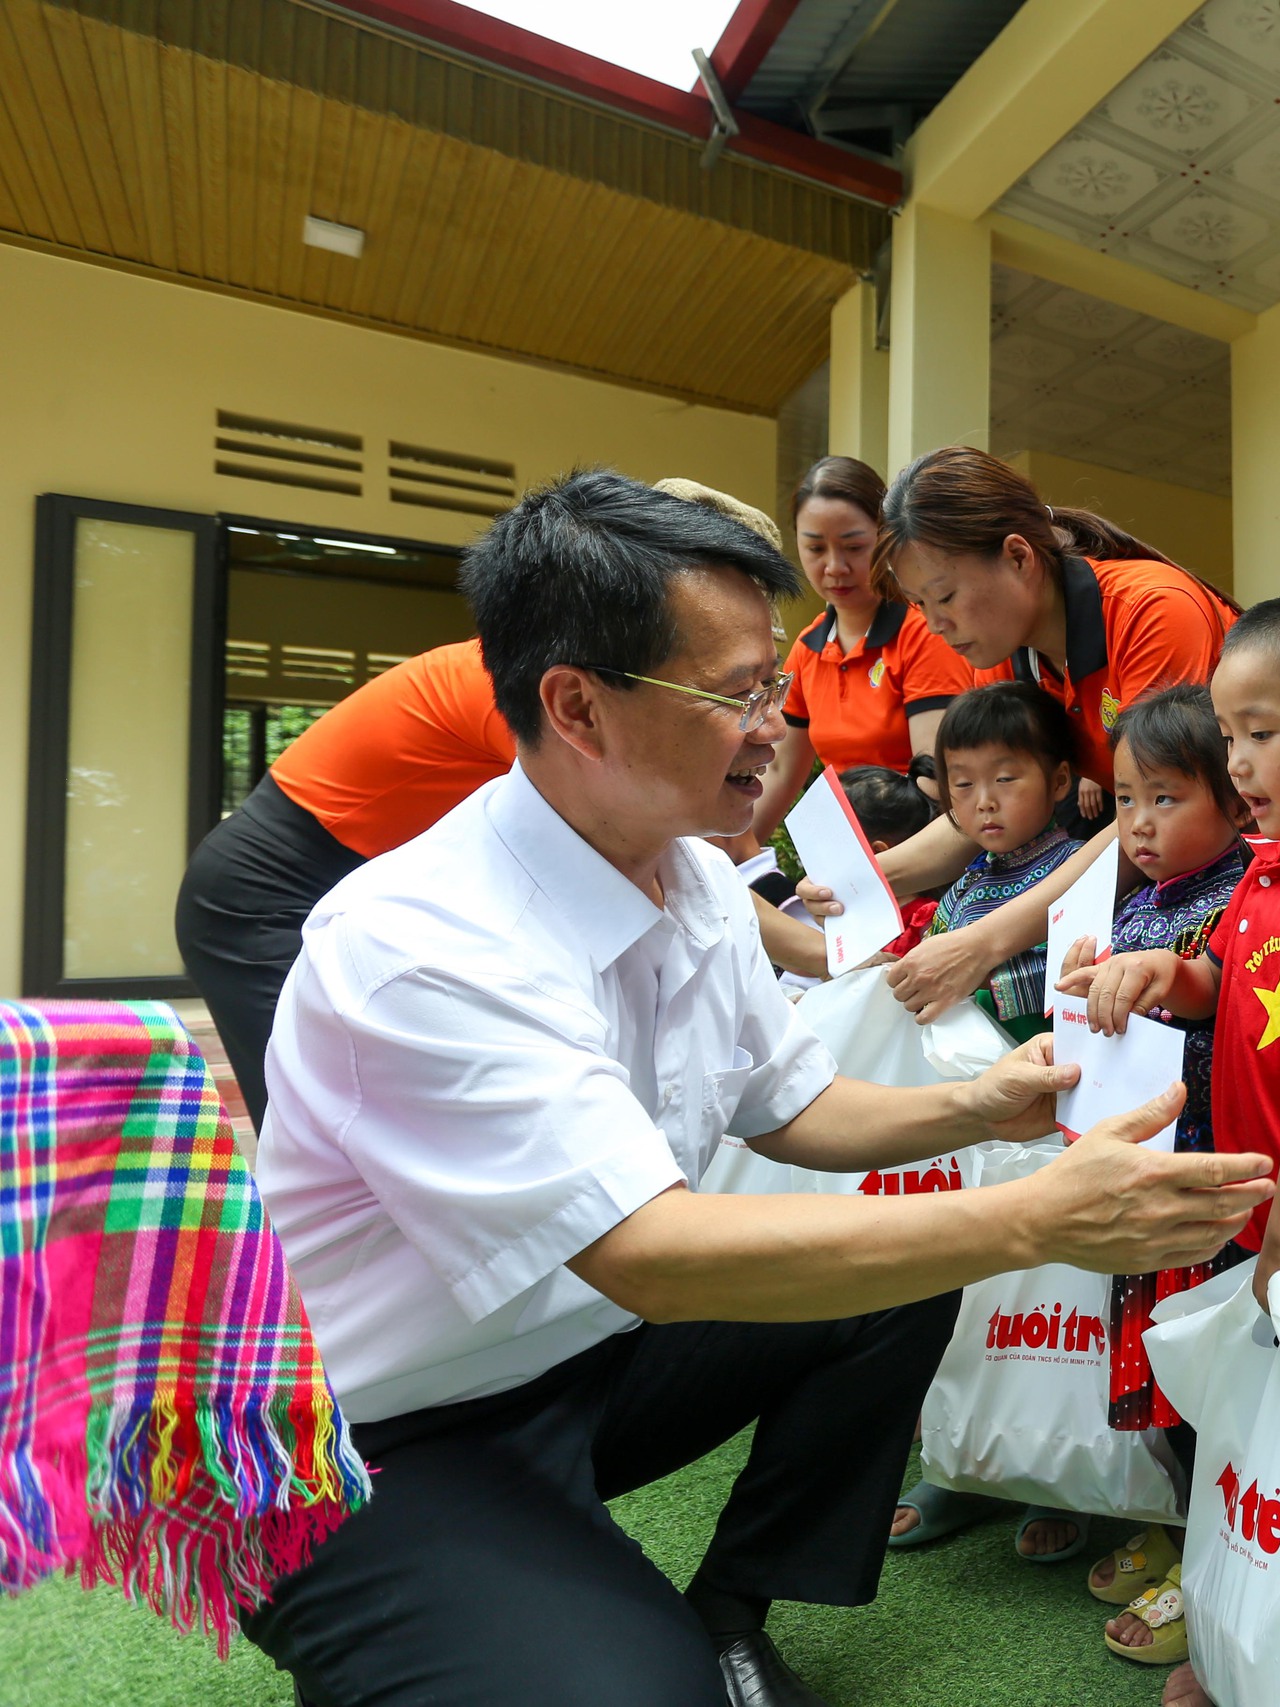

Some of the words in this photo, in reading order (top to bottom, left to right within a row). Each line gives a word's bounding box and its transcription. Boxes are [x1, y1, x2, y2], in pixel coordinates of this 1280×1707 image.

[985, 1302, 1062, 1350] tuổi
[1038, 1355, 1052, 1363] TNCS
[1070, 1358, 1085, 1366] MINH
